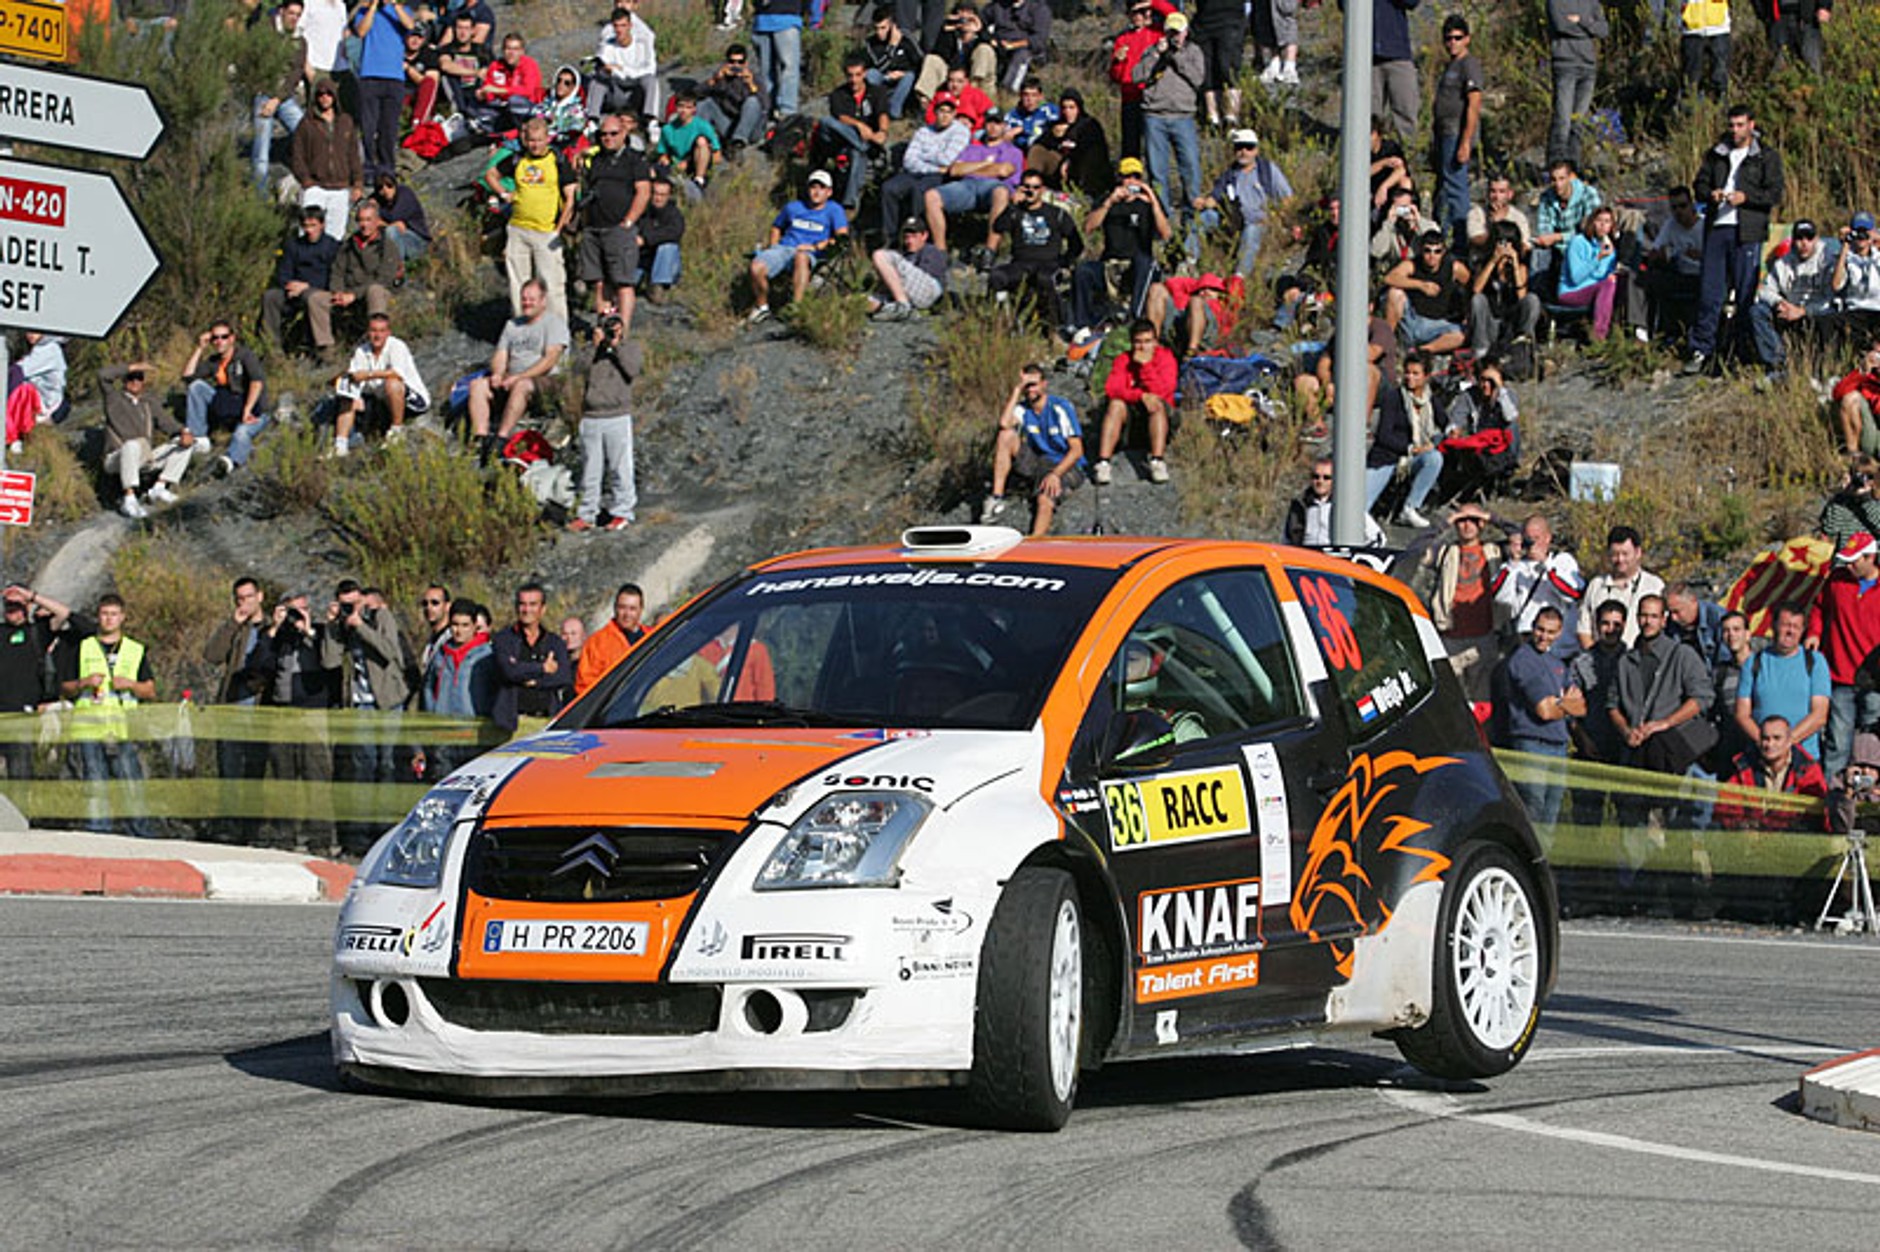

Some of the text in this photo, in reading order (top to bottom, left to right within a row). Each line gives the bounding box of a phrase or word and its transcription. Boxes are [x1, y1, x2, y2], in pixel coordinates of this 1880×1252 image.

[0, 184, 62, 219] N-420
[0, 235, 96, 275] DELL T.
[0, 279, 45, 313] SET
[1299, 576, 1363, 672] 36
[1106, 783, 1147, 847] 36
[1161, 780, 1229, 831] RACC
[512, 925, 636, 951] H PR 2206
[1142, 883, 1259, 953] KNAF
[1140, 960, 1257, 995] Talent First
